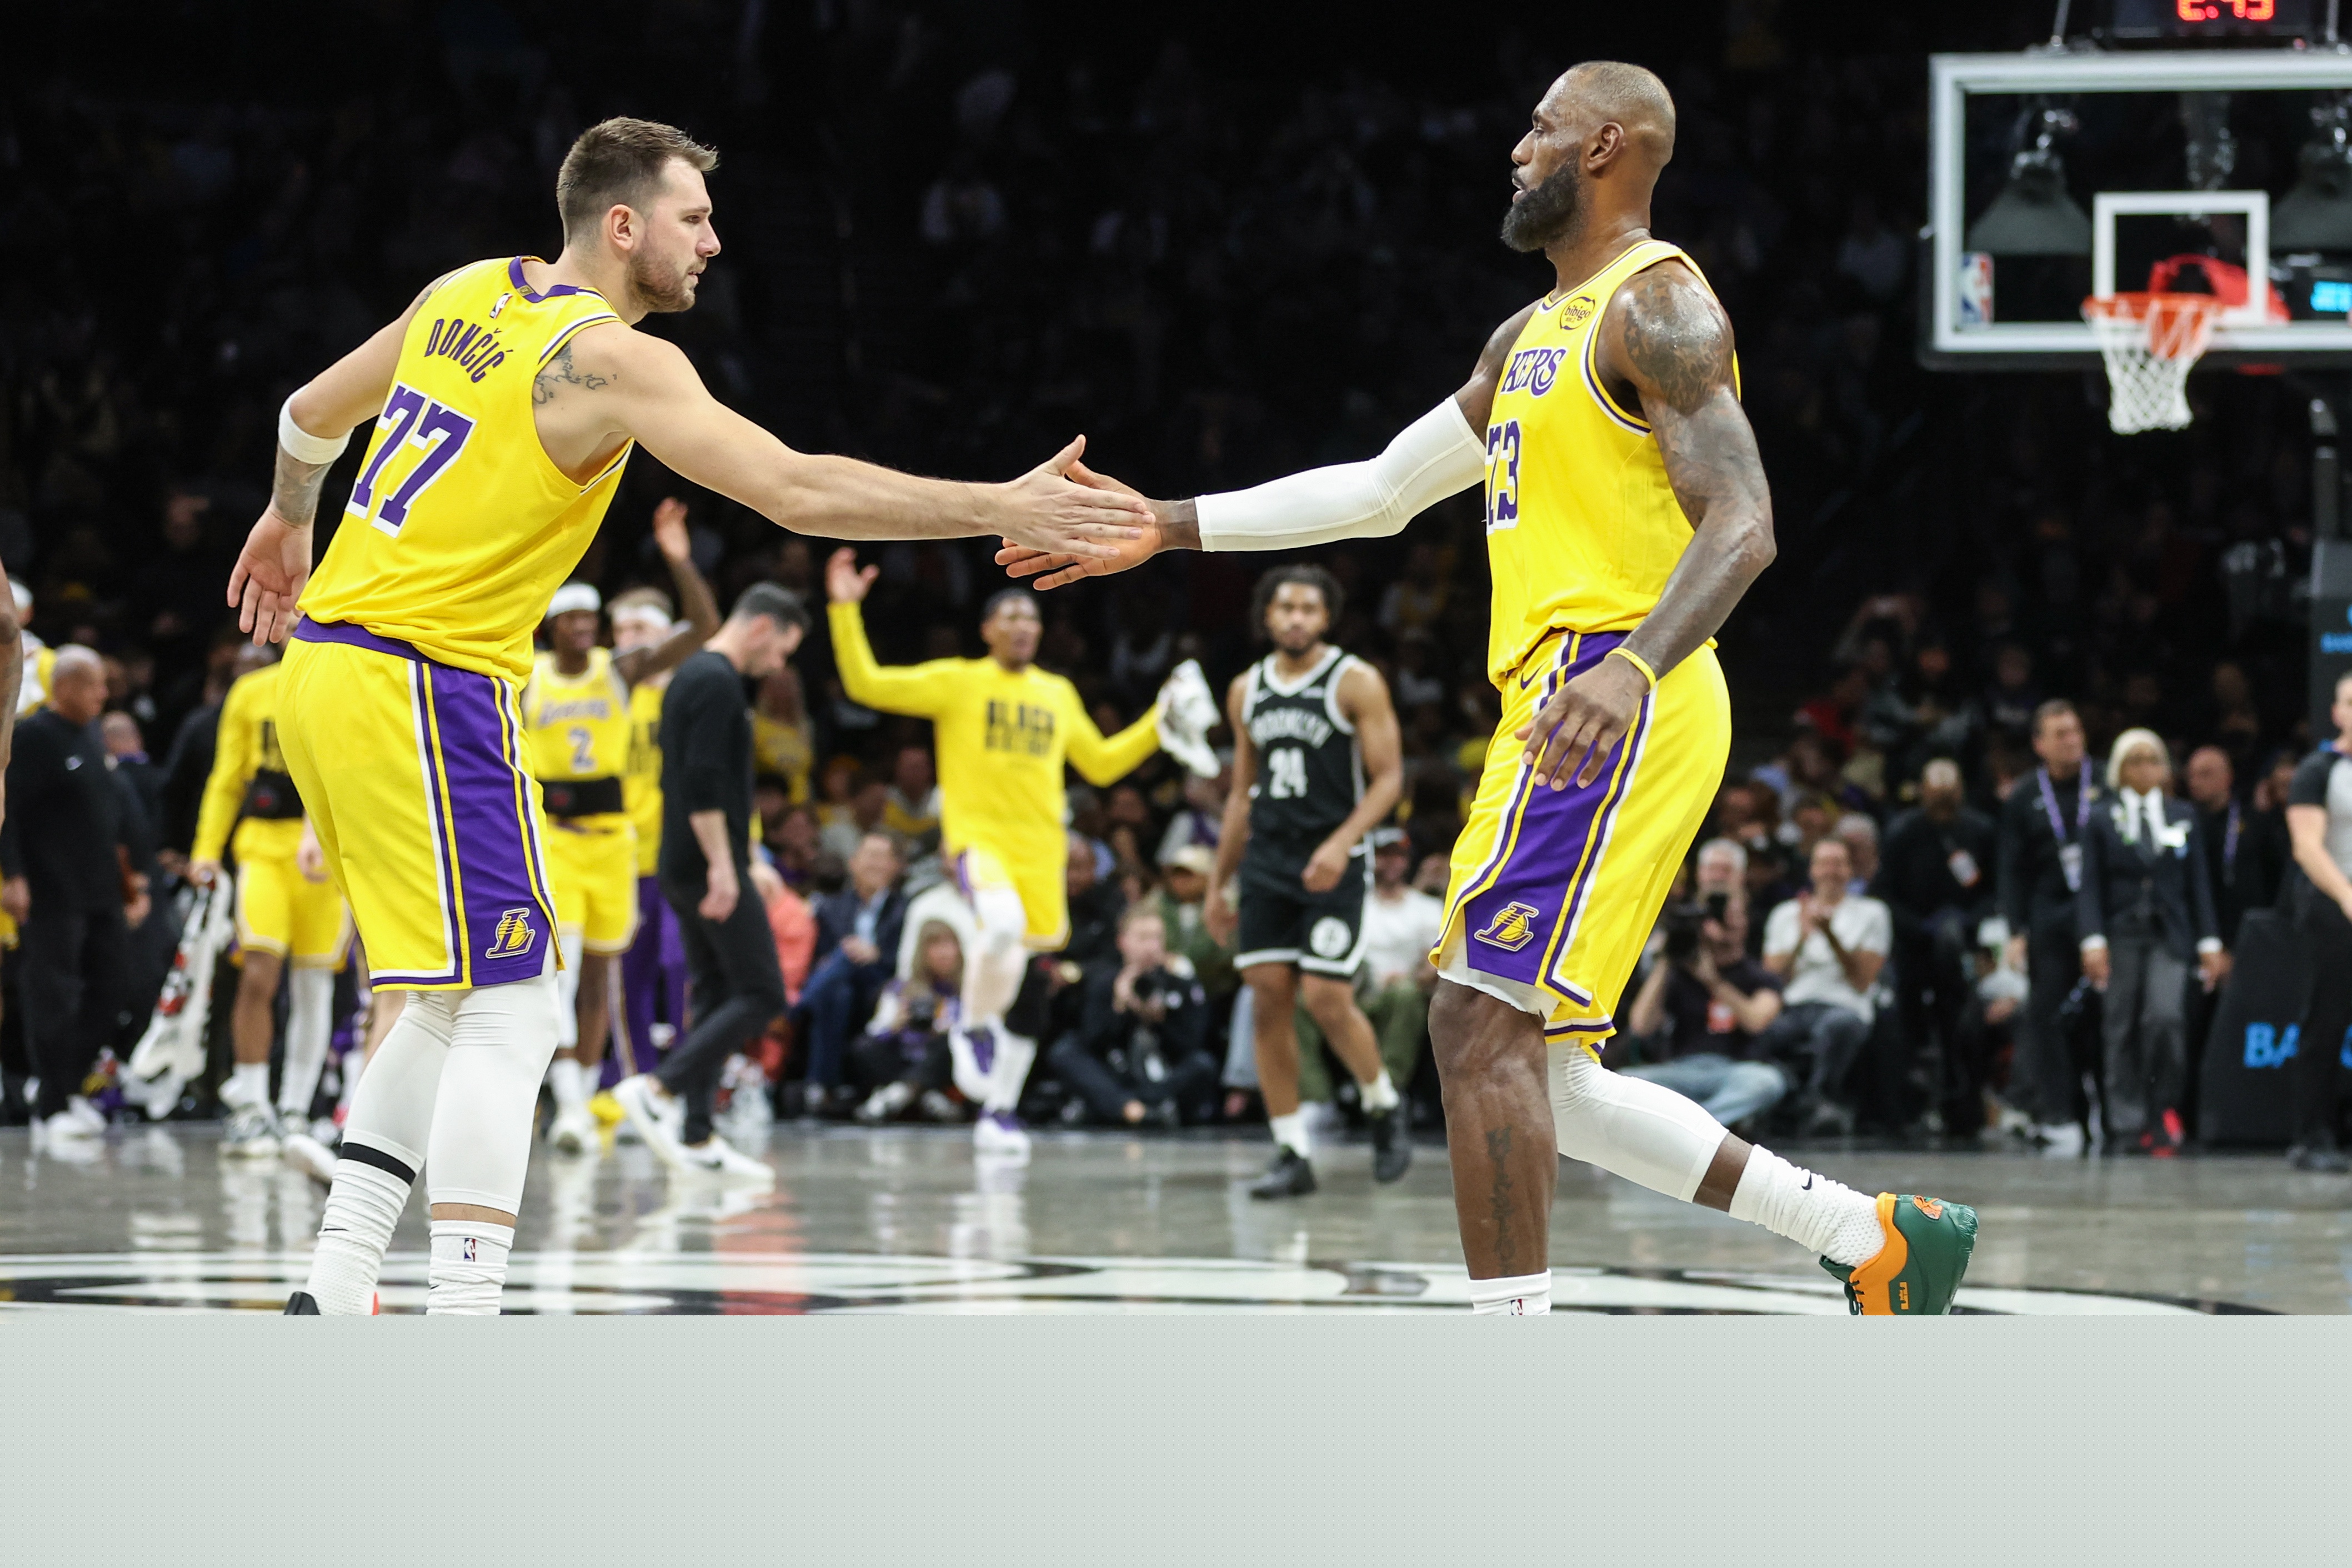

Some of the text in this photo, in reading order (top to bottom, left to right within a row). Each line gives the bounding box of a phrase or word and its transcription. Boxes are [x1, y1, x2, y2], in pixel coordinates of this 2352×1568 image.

[1564, 305, 1591, 321] bibigo
[424, 318, 513, 383] DONČIĆ
[1500, 347, 1568, 398] KERS
[346, 382, 477, 538] 77
[568, 728, 597, 774] 2
[1268, 748, 1308, 799] 24
